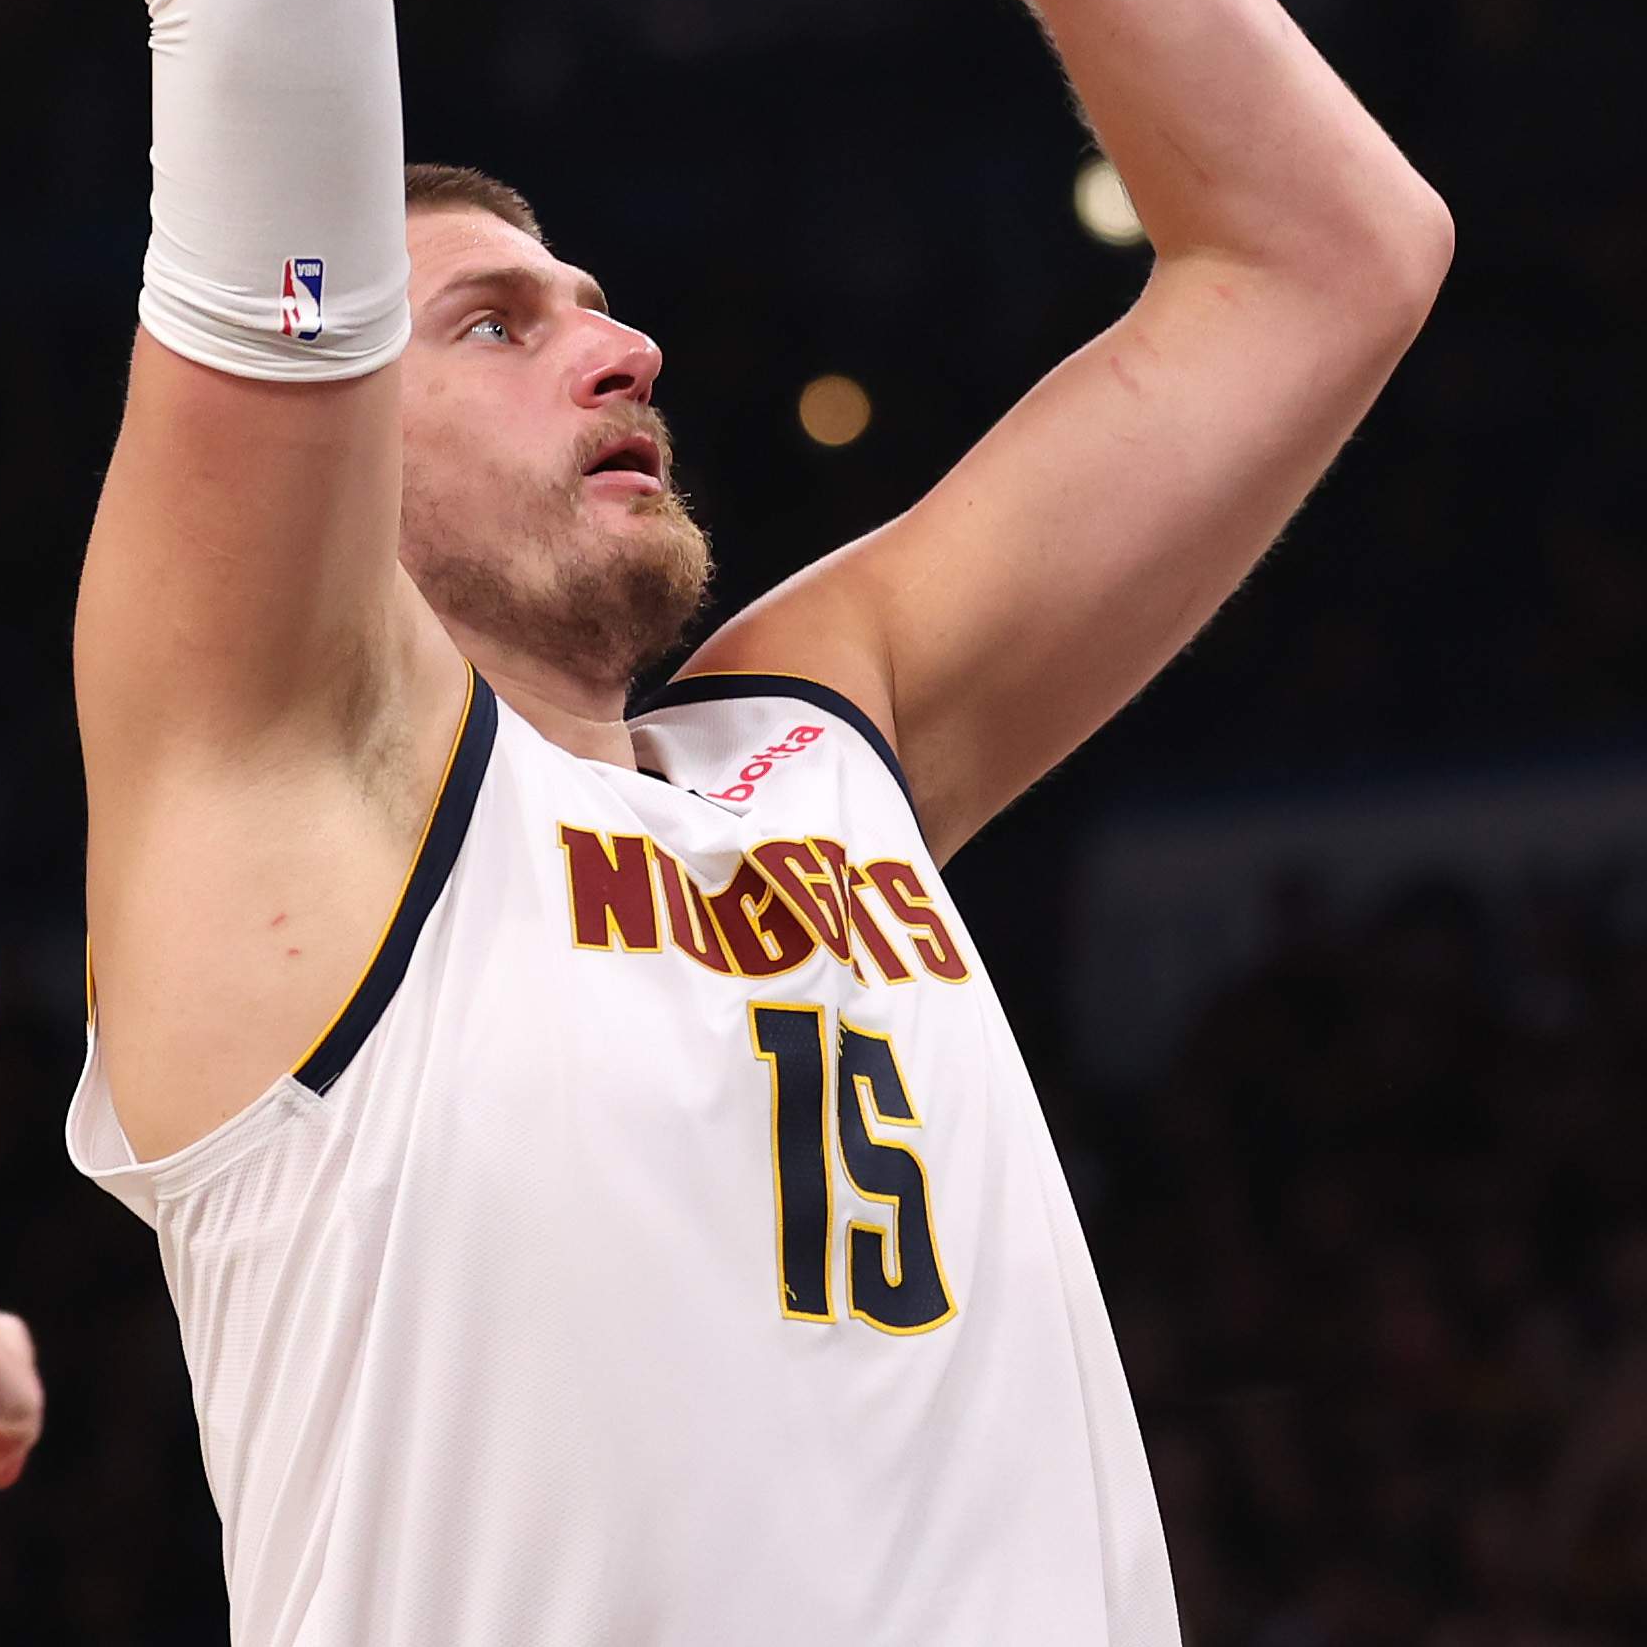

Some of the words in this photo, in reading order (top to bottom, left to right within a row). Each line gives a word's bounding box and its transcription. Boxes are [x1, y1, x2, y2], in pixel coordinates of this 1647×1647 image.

[706, 725, 825, 802] botta
[556, 820, 973, 990] NUGGTS
[747, 1000, 959, 1337] 15
